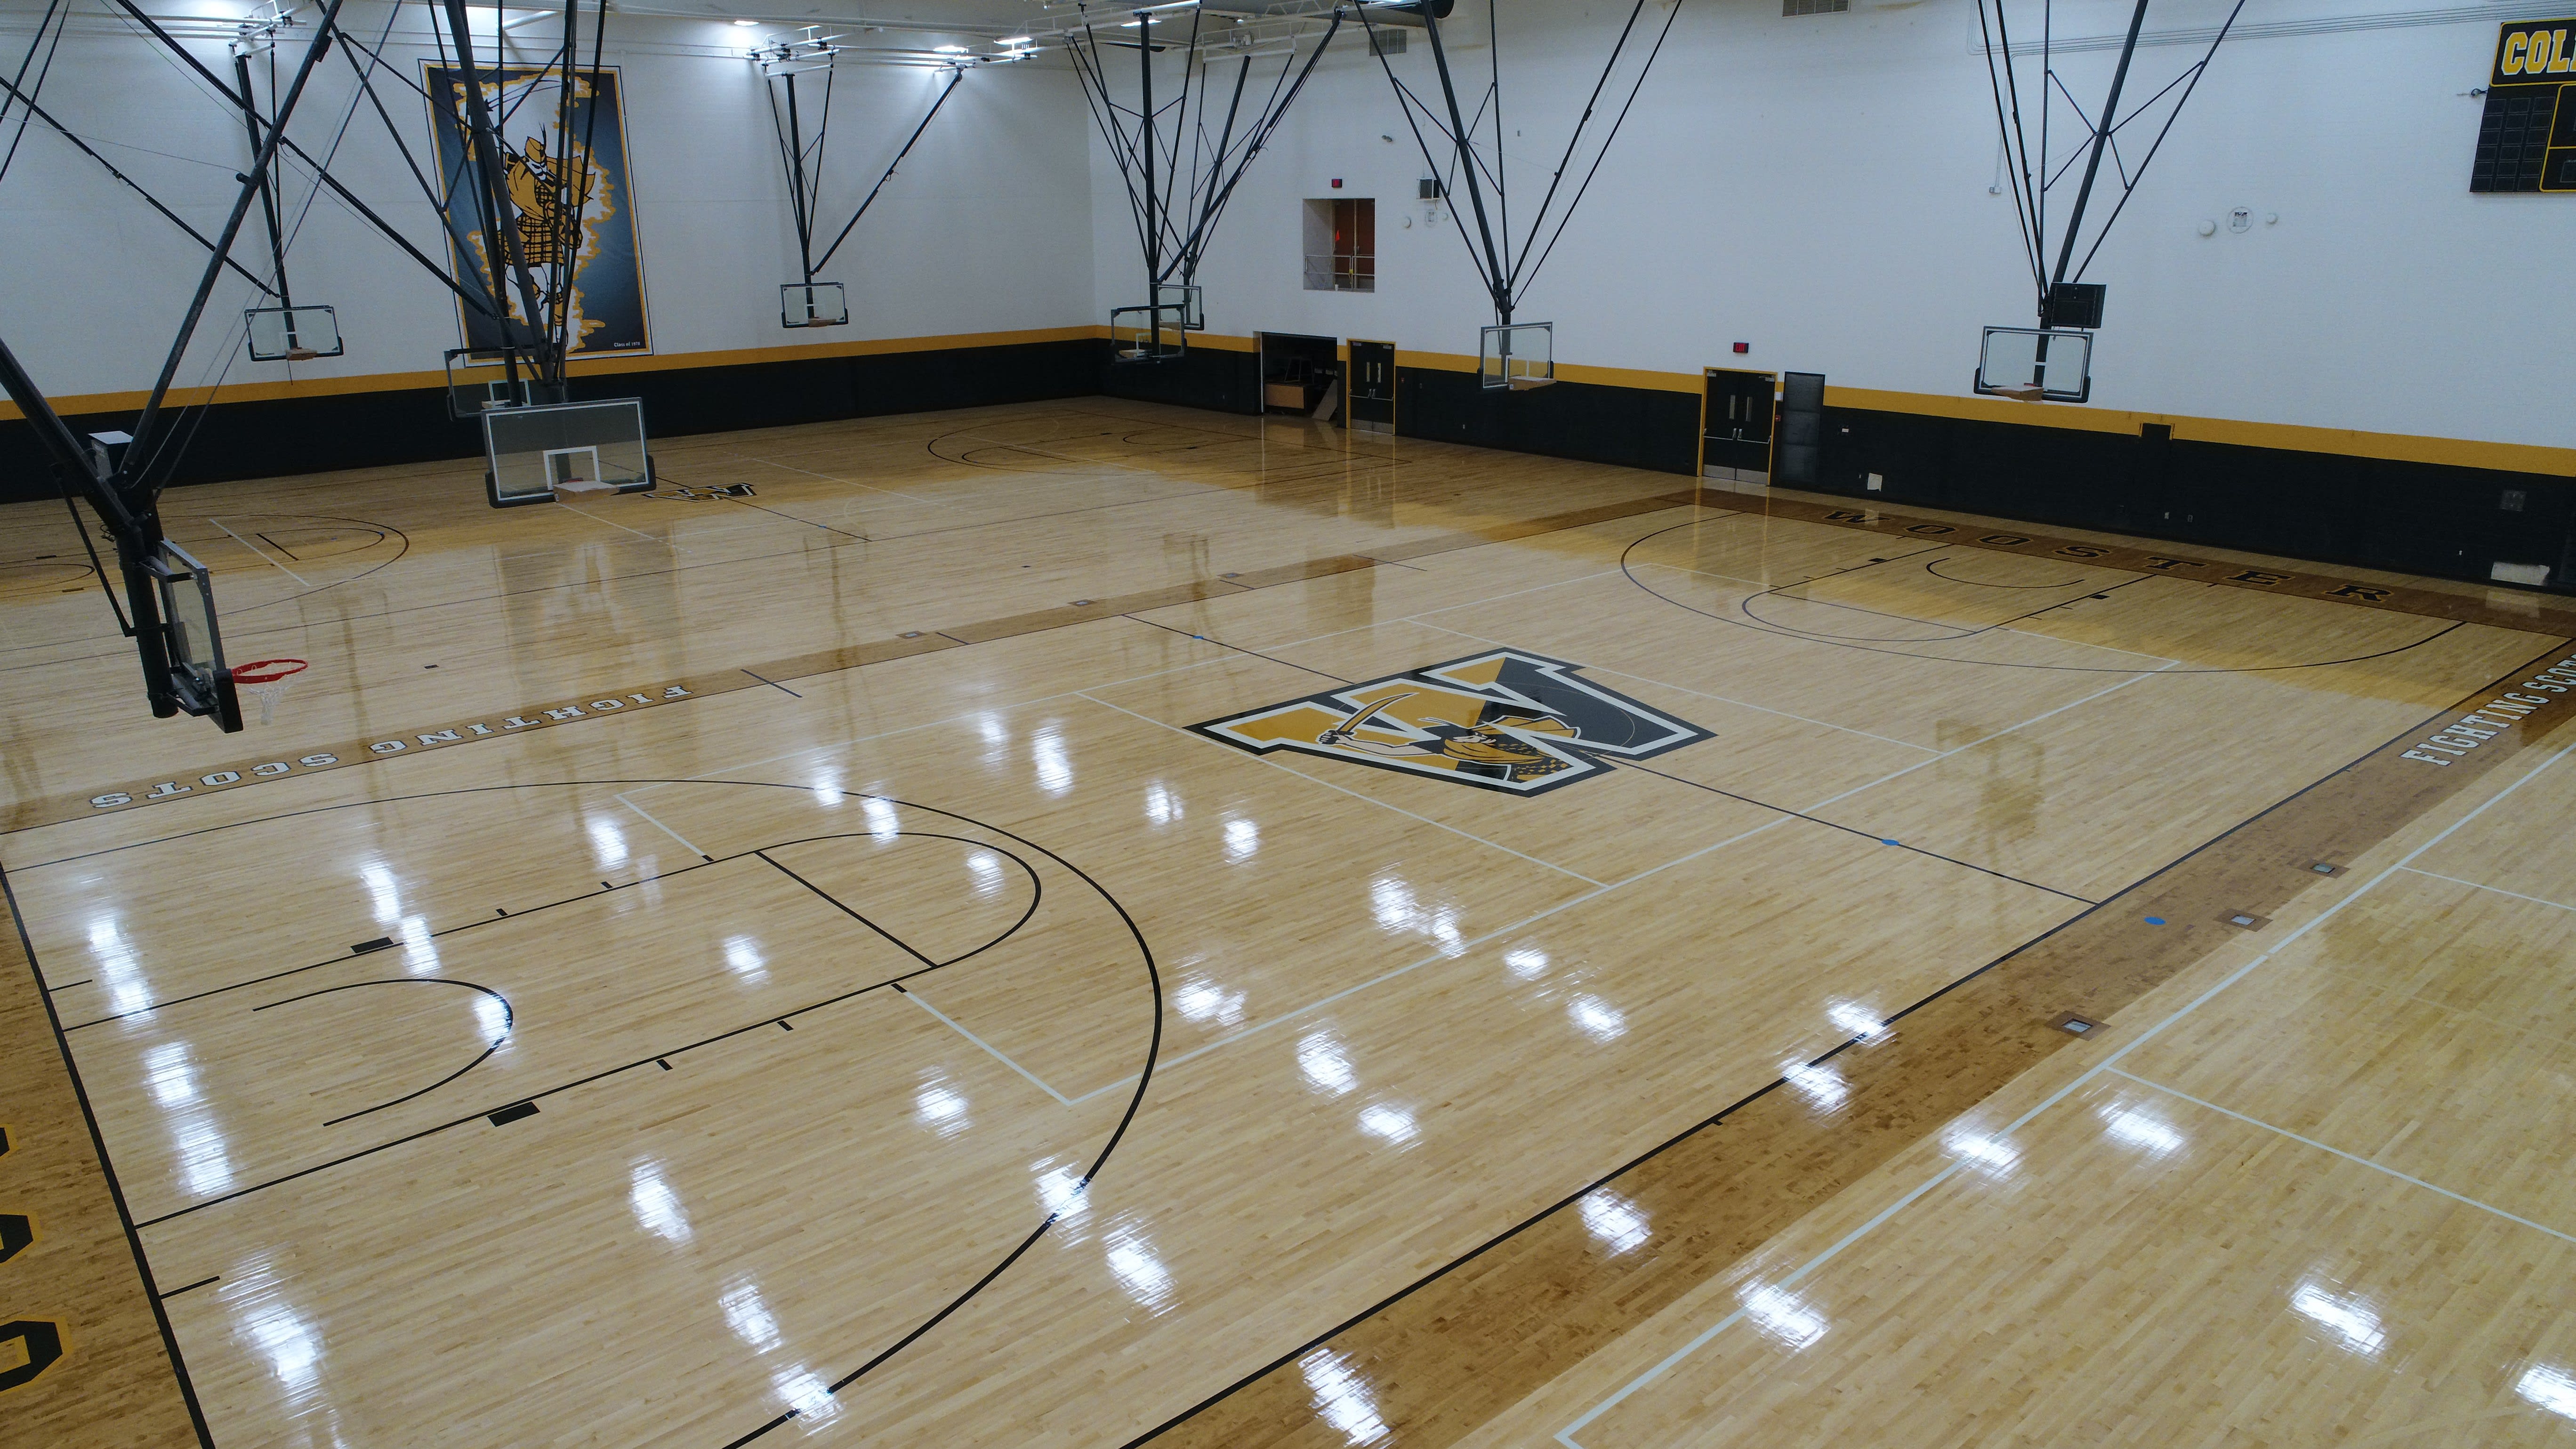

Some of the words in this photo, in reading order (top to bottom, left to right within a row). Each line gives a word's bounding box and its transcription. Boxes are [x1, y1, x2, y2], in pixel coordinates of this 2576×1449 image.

[2501, 29, 2576, 75] COL
[1822, 510, 2394, 603] WOOSTER
[370, 685, 692, 754] FIGHTING
[2399, 692, 2551, 766] FIGHTING
[2521, 653, 2576, 692] SCO
[90, 753, 339, 808] SCOTS
